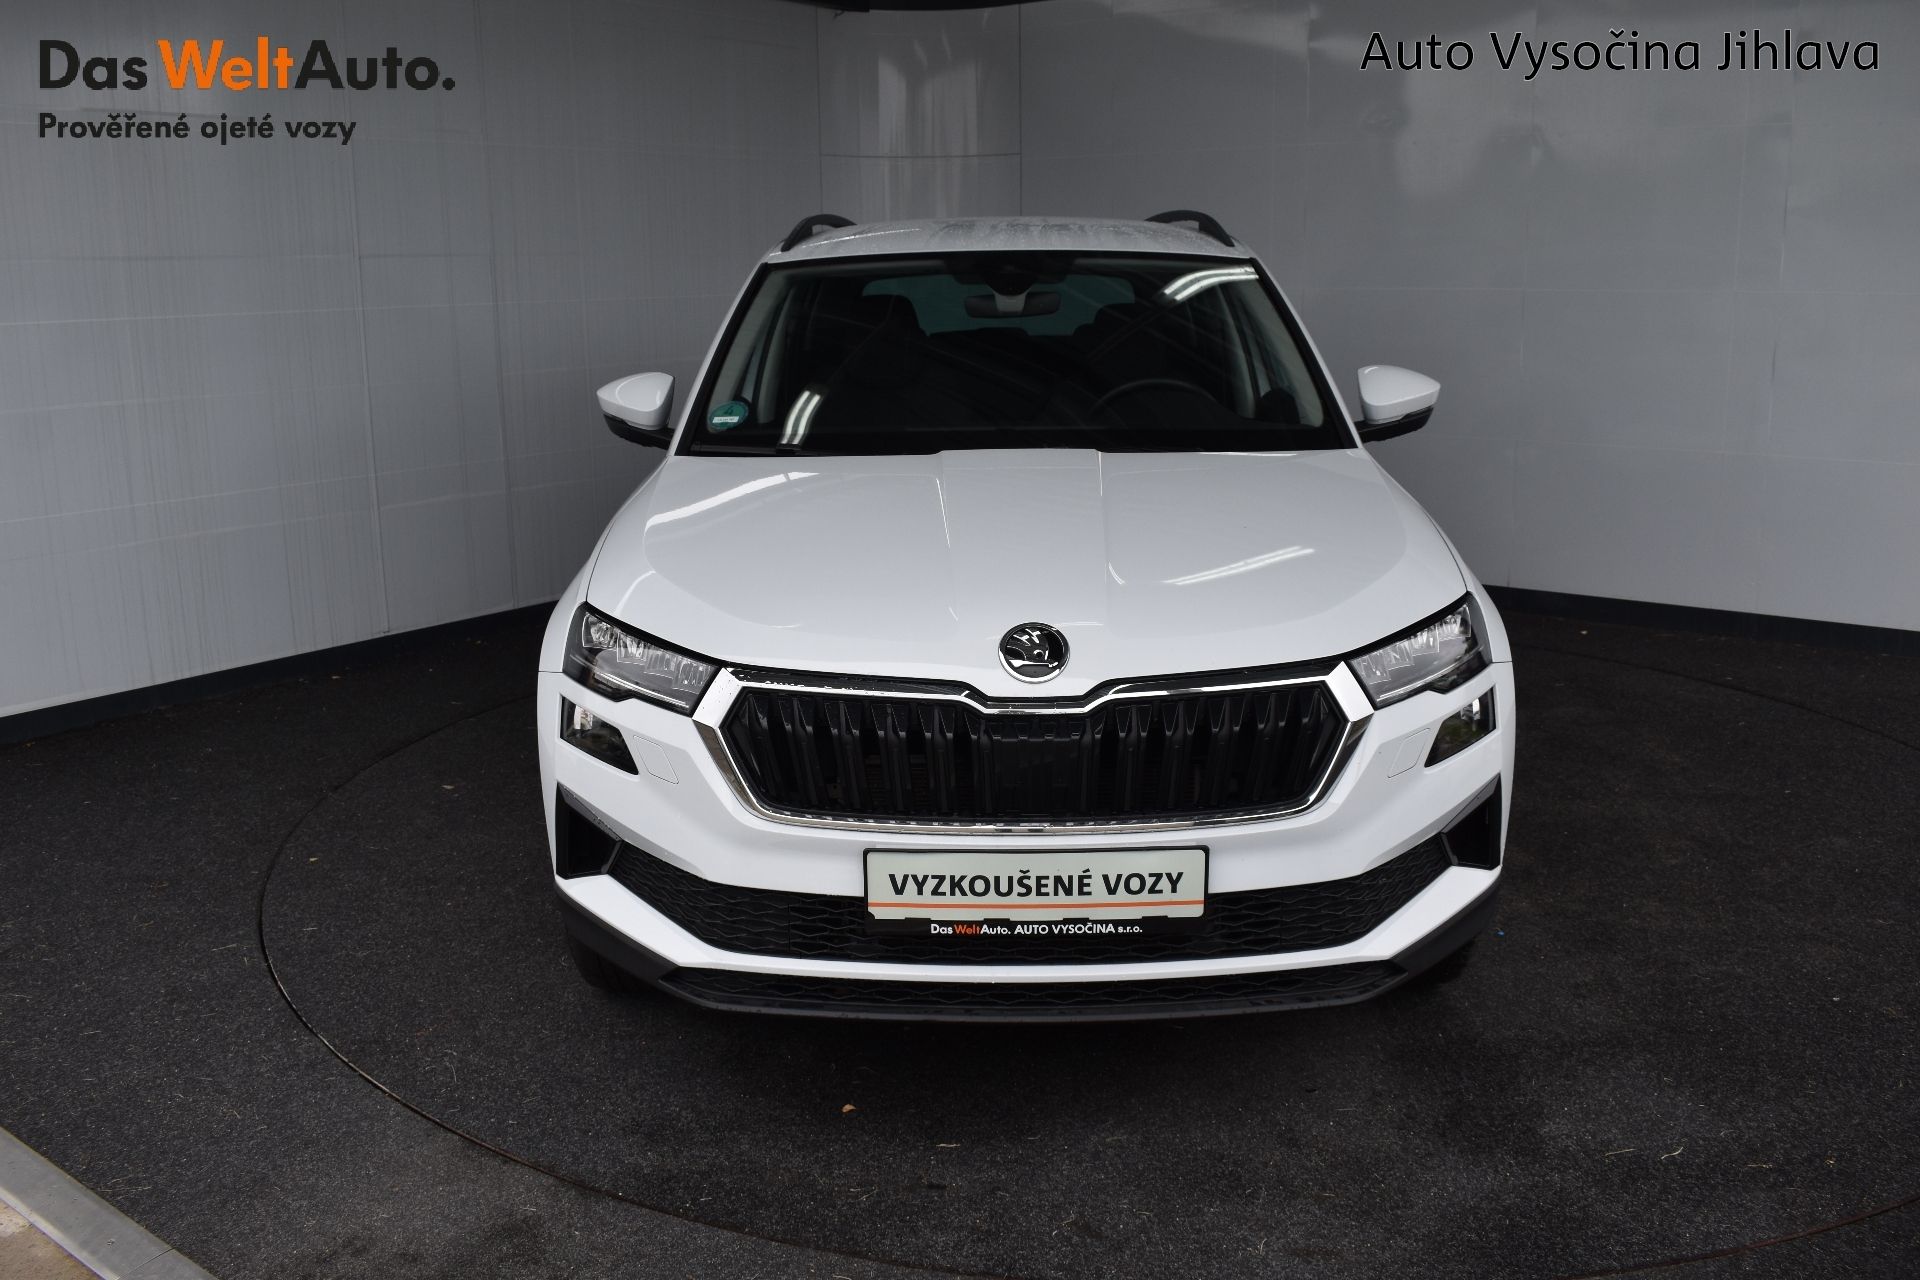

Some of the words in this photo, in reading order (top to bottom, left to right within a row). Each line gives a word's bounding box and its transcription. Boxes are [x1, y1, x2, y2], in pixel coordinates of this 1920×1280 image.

[888, 868, 1093, 897] VYZKOUŠENÉ
[1102, 871, 1184, 895] VOZY
[931, 923, 953, 935] Das
[1014, 923, 1049, 935] AUTO
[1052, 921, 1116, 935] VYSOČINA
[1117, 926, 1143, 934] s.r.o.
